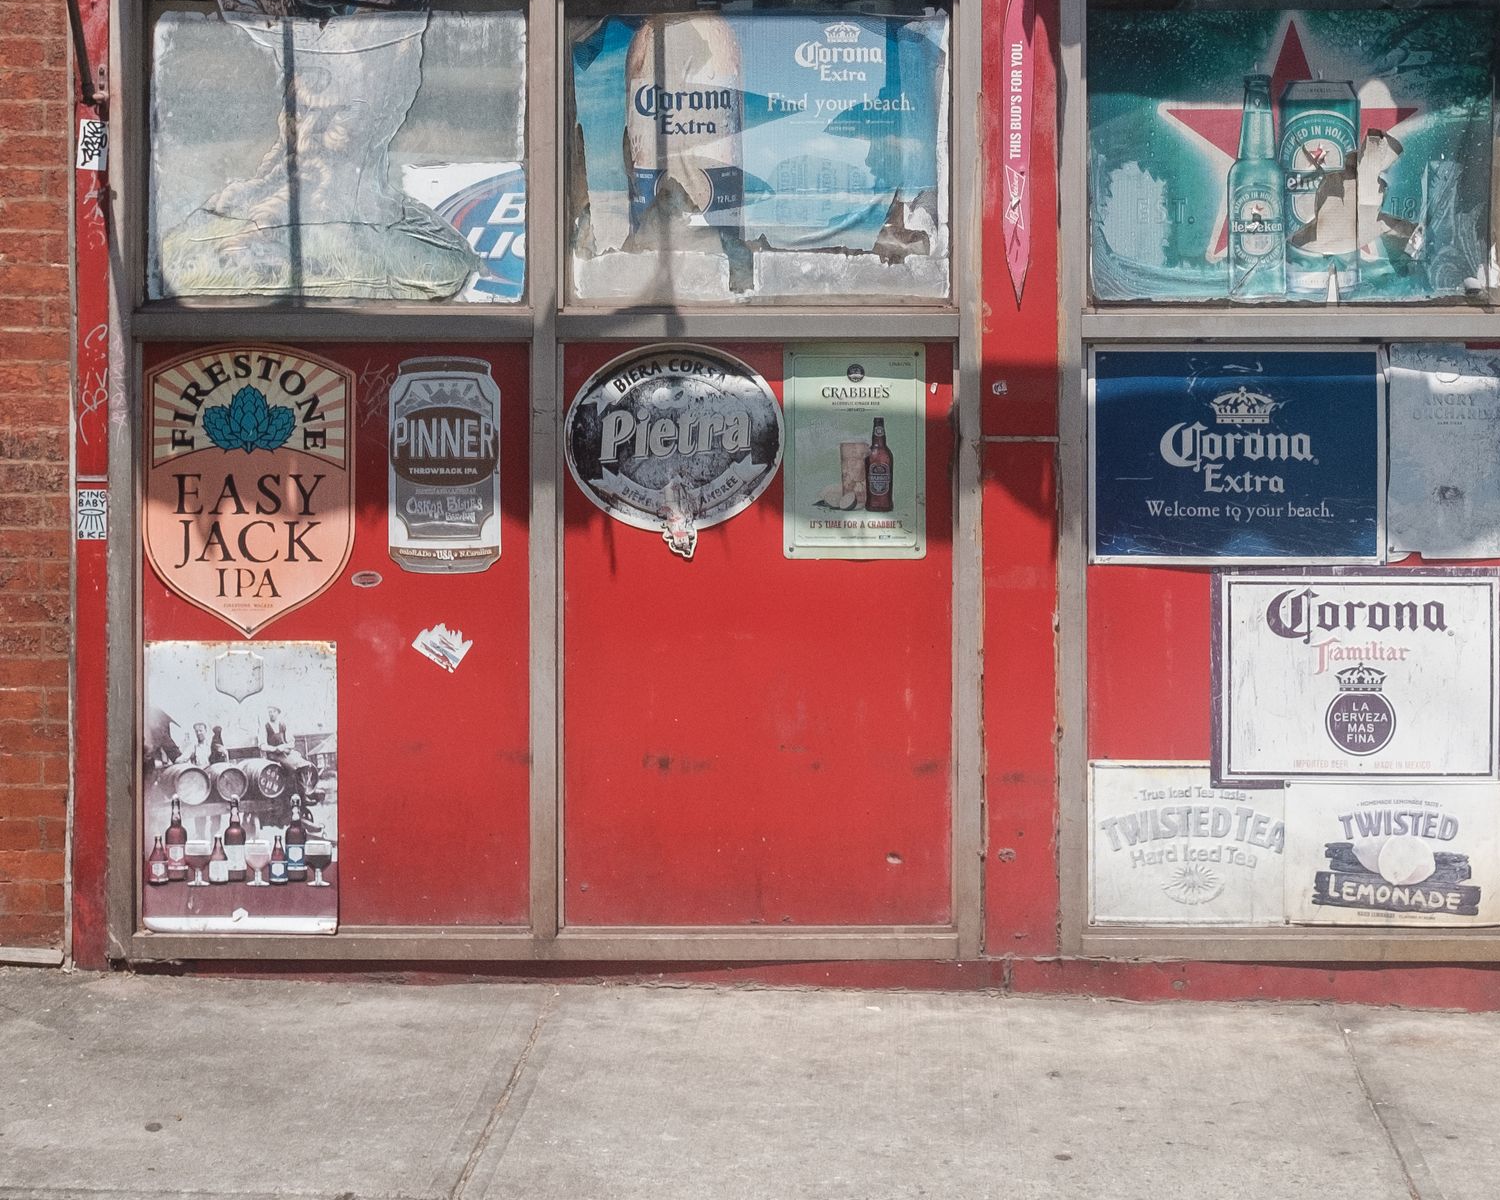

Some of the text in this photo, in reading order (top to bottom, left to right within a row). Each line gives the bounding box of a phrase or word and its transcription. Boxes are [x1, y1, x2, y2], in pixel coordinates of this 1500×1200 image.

[794, 40, 883, 71] Corona
[820, 65, 867, 83] Extra
[634, 84, 732, 118] Corona
[767, 92, 916, 118] Find your beach.
[1010, 40, 1024, 160] THIS BUD'S FOR YOU.
[660, 113, 717, 136] Extra
[1134, 197, 1196, 225] EST.
[613, 361, 661, 394] BIERA
[821, 384, 891, 399] CRABBIE'S
[172, 354, 328, 452] FIRESTONE
[393, 418, 494, 460] PINNER
[600, 409, 751, 462] Pietra
[1160, 421, 1314, 472] Corona
[409, 467, 478, 475] THROWBACK IPA
[1203, 464, 1286, 494] Extra
[79, 491, 106, 499] KING
[79, 499, 106, 507] BABY
[172, 473, 327, 516] EASY
[824, 520, 842, 528] TIME
[843, 520, 858, 528] FOR
[859, 520, 866, 528] A
[867, 520, 903, 529] CRABBIE'S
[1146, 500, 1335, 522] Welcome to your beach.
[174, 520, 323, 569] JACK
[436, 549, 454, 560] USA
[216, 568, 282, 598] IPA
[1266, 587, 1448, 644] Corona
[1311, 637, 1411, 676] Familiar
[1334, 712, 1388, 723] CERVEZA
[1353, 702, 1369, 711] LA
[1346, 734, 1375, 743] FINA
[1347, 723, 1375, 733] MAS
[1293, 760, 1431, 770] IMPORTED BEER MADE IN MEXICO
[1139, 786, 1166, 801] True
[1169, 785, 1193, 799] Iced
[1195, 785, 1214, 799] Tea
[1098, 805, 1286, 855] TWISTED TEA
[1338, 809, 1460, 841] TWISTED
[1130, 843, 1259, 869] Hard Iced Tea
[1328, 873, 1462, 910] LEMONADE
